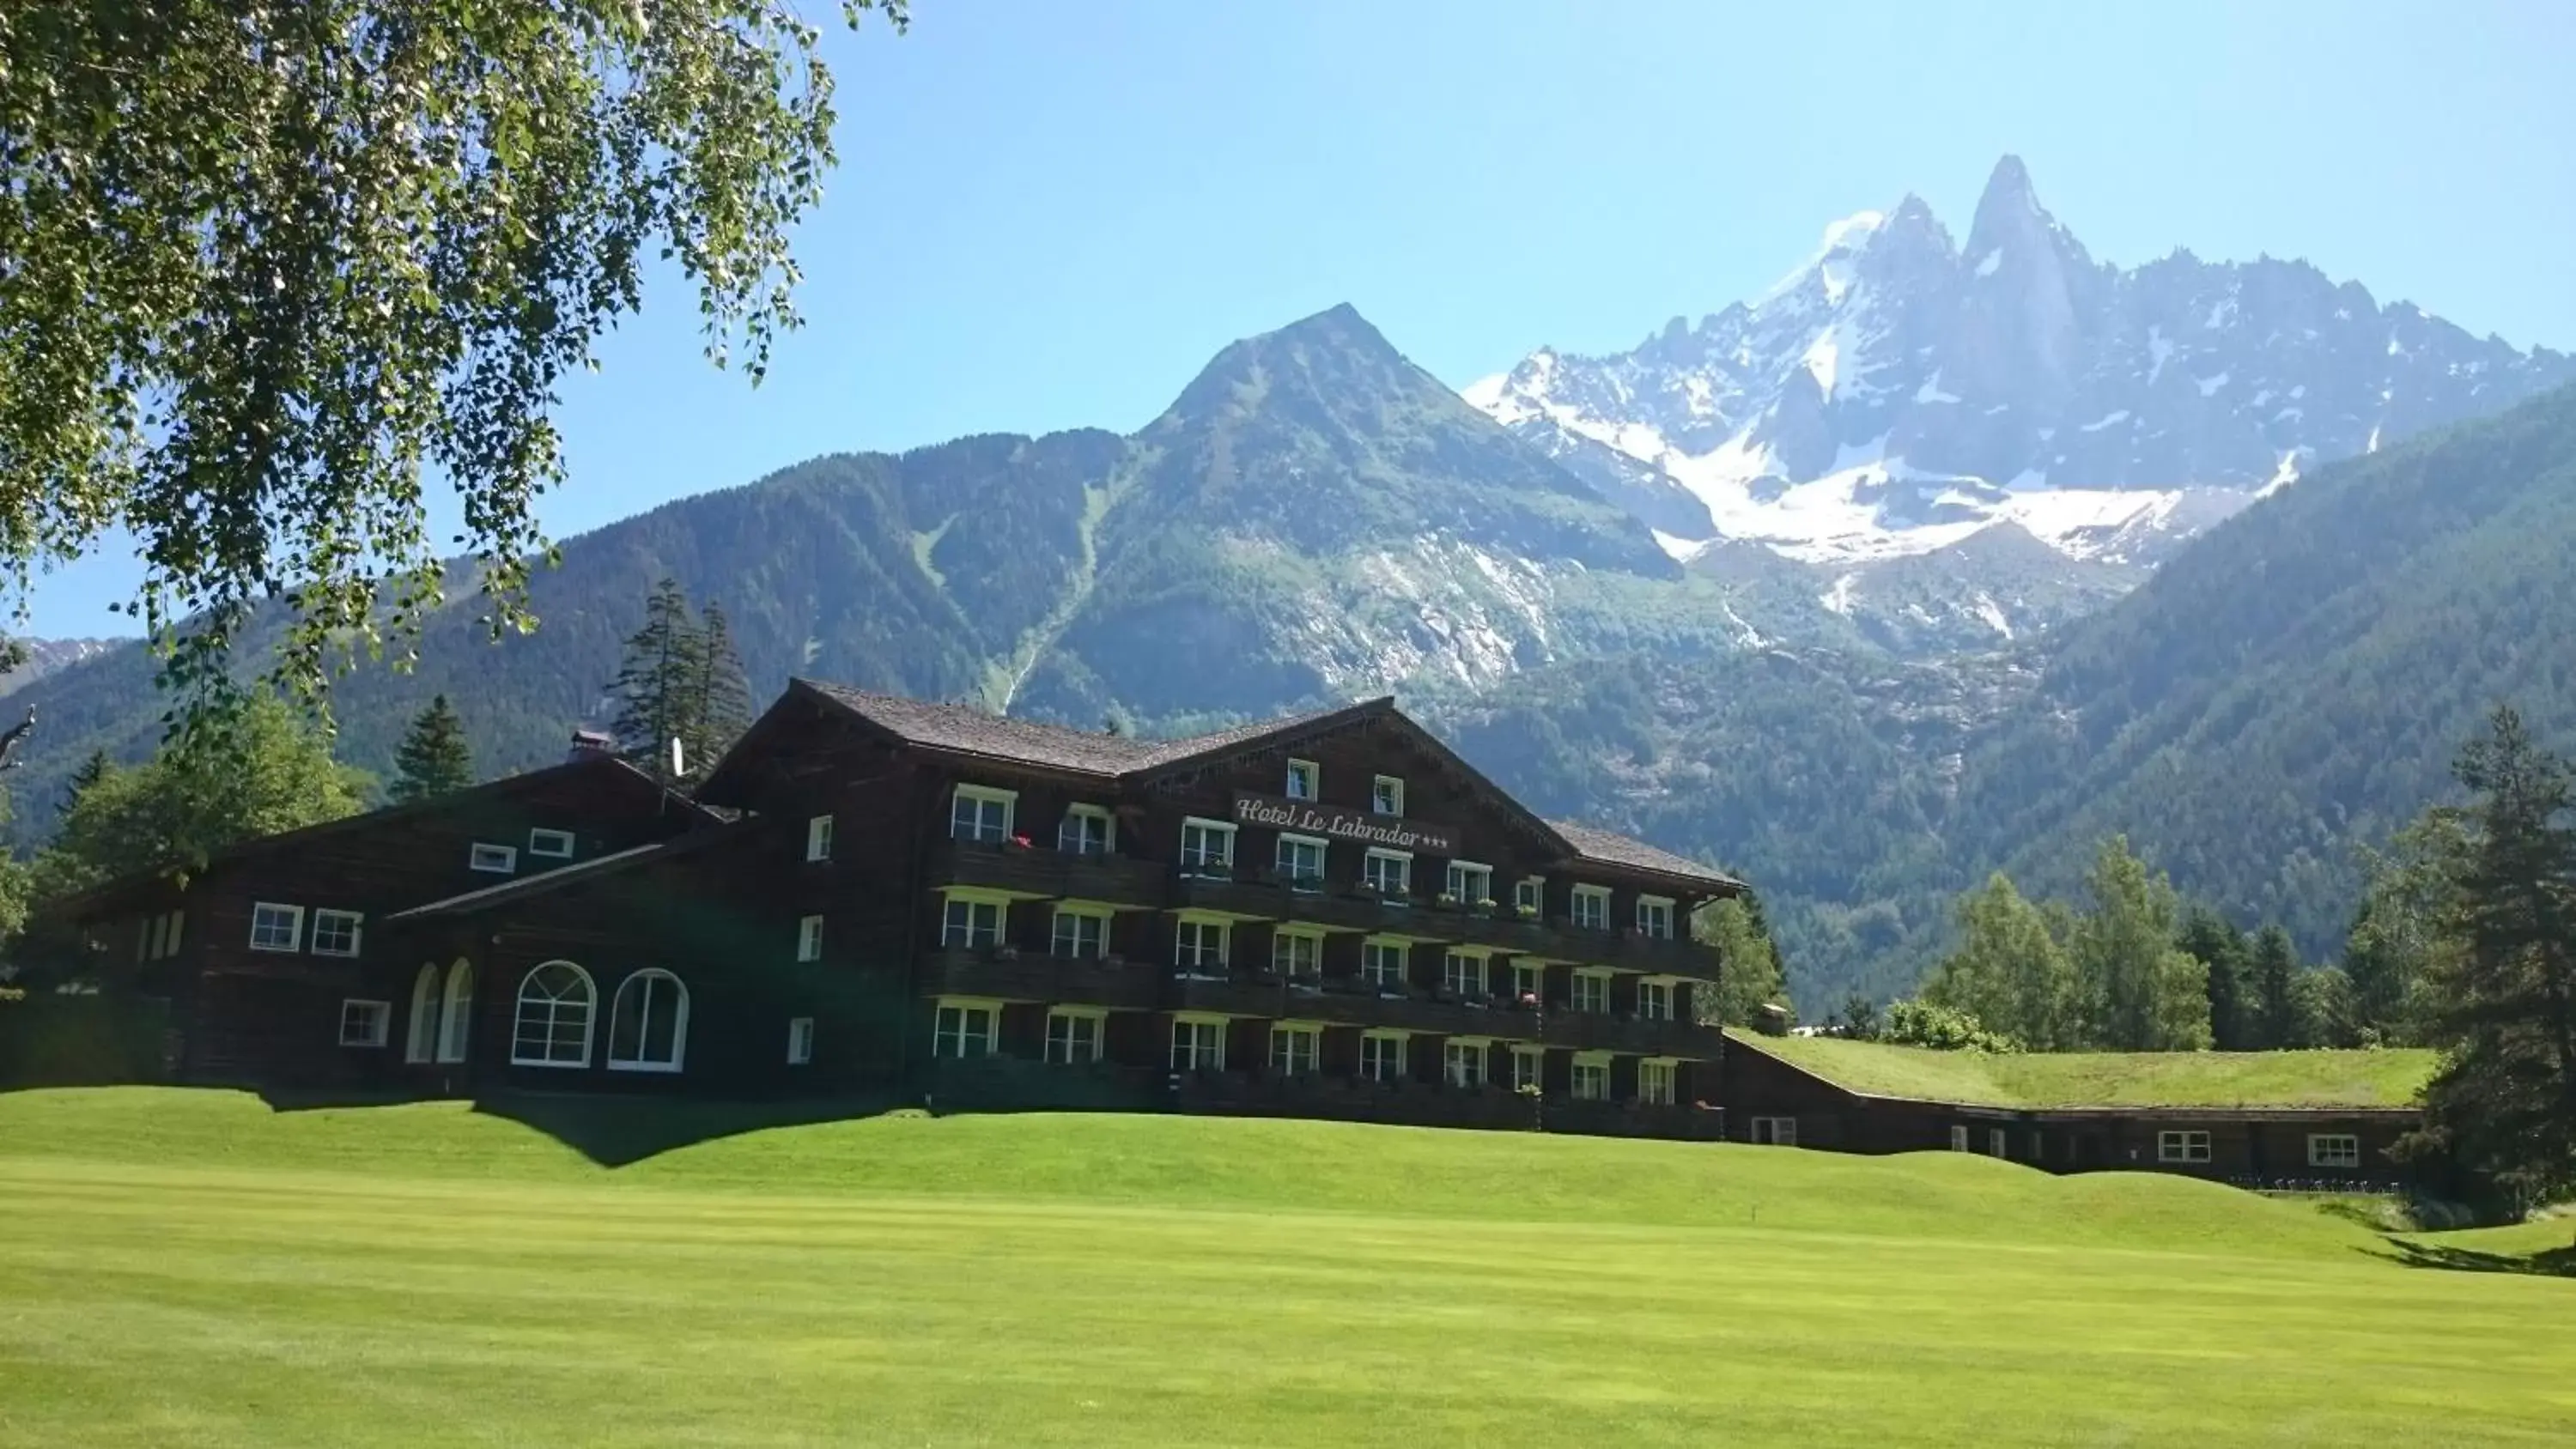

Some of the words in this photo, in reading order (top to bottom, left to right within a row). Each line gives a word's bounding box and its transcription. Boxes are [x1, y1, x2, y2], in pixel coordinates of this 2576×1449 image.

[1236, 799, 1297, 826] Hotel
[1298, 810, 1327, 831] Le
[1328, 815, 1419, 846] Labrador
